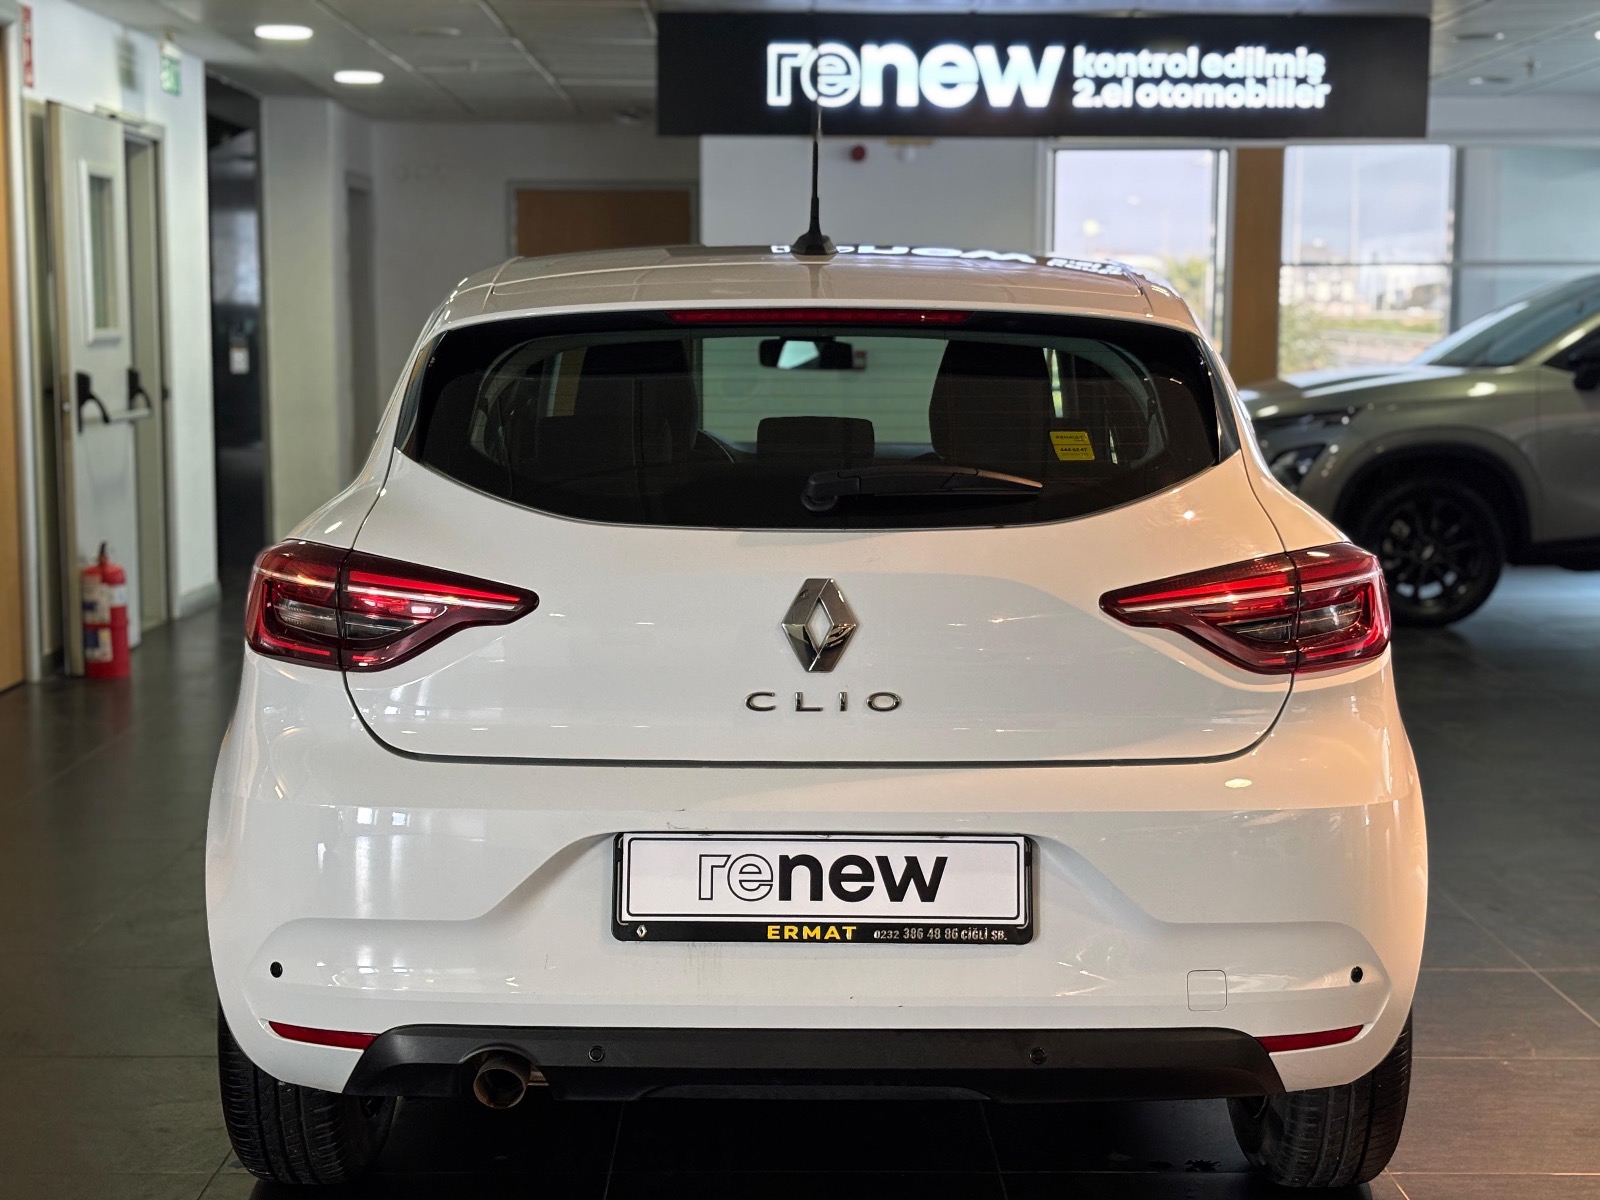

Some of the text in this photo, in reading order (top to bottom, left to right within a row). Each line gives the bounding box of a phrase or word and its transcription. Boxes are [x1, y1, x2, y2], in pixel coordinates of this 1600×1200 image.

[766, 43, 1066, 108] renew
[1073, 45, 1326, 85] kontrol edilmiş
[1072, 77, 1332, 109] 2.el otomobiller
[745, 691, 902, 712] CLIO
[698, 853, 949, 903] renew
[767, 925, 857, 940] ERMAT
[873, 929, 900, 940] 0232
[926, 927, 941, 940] 48
[944, 927, 959, 940] 86
